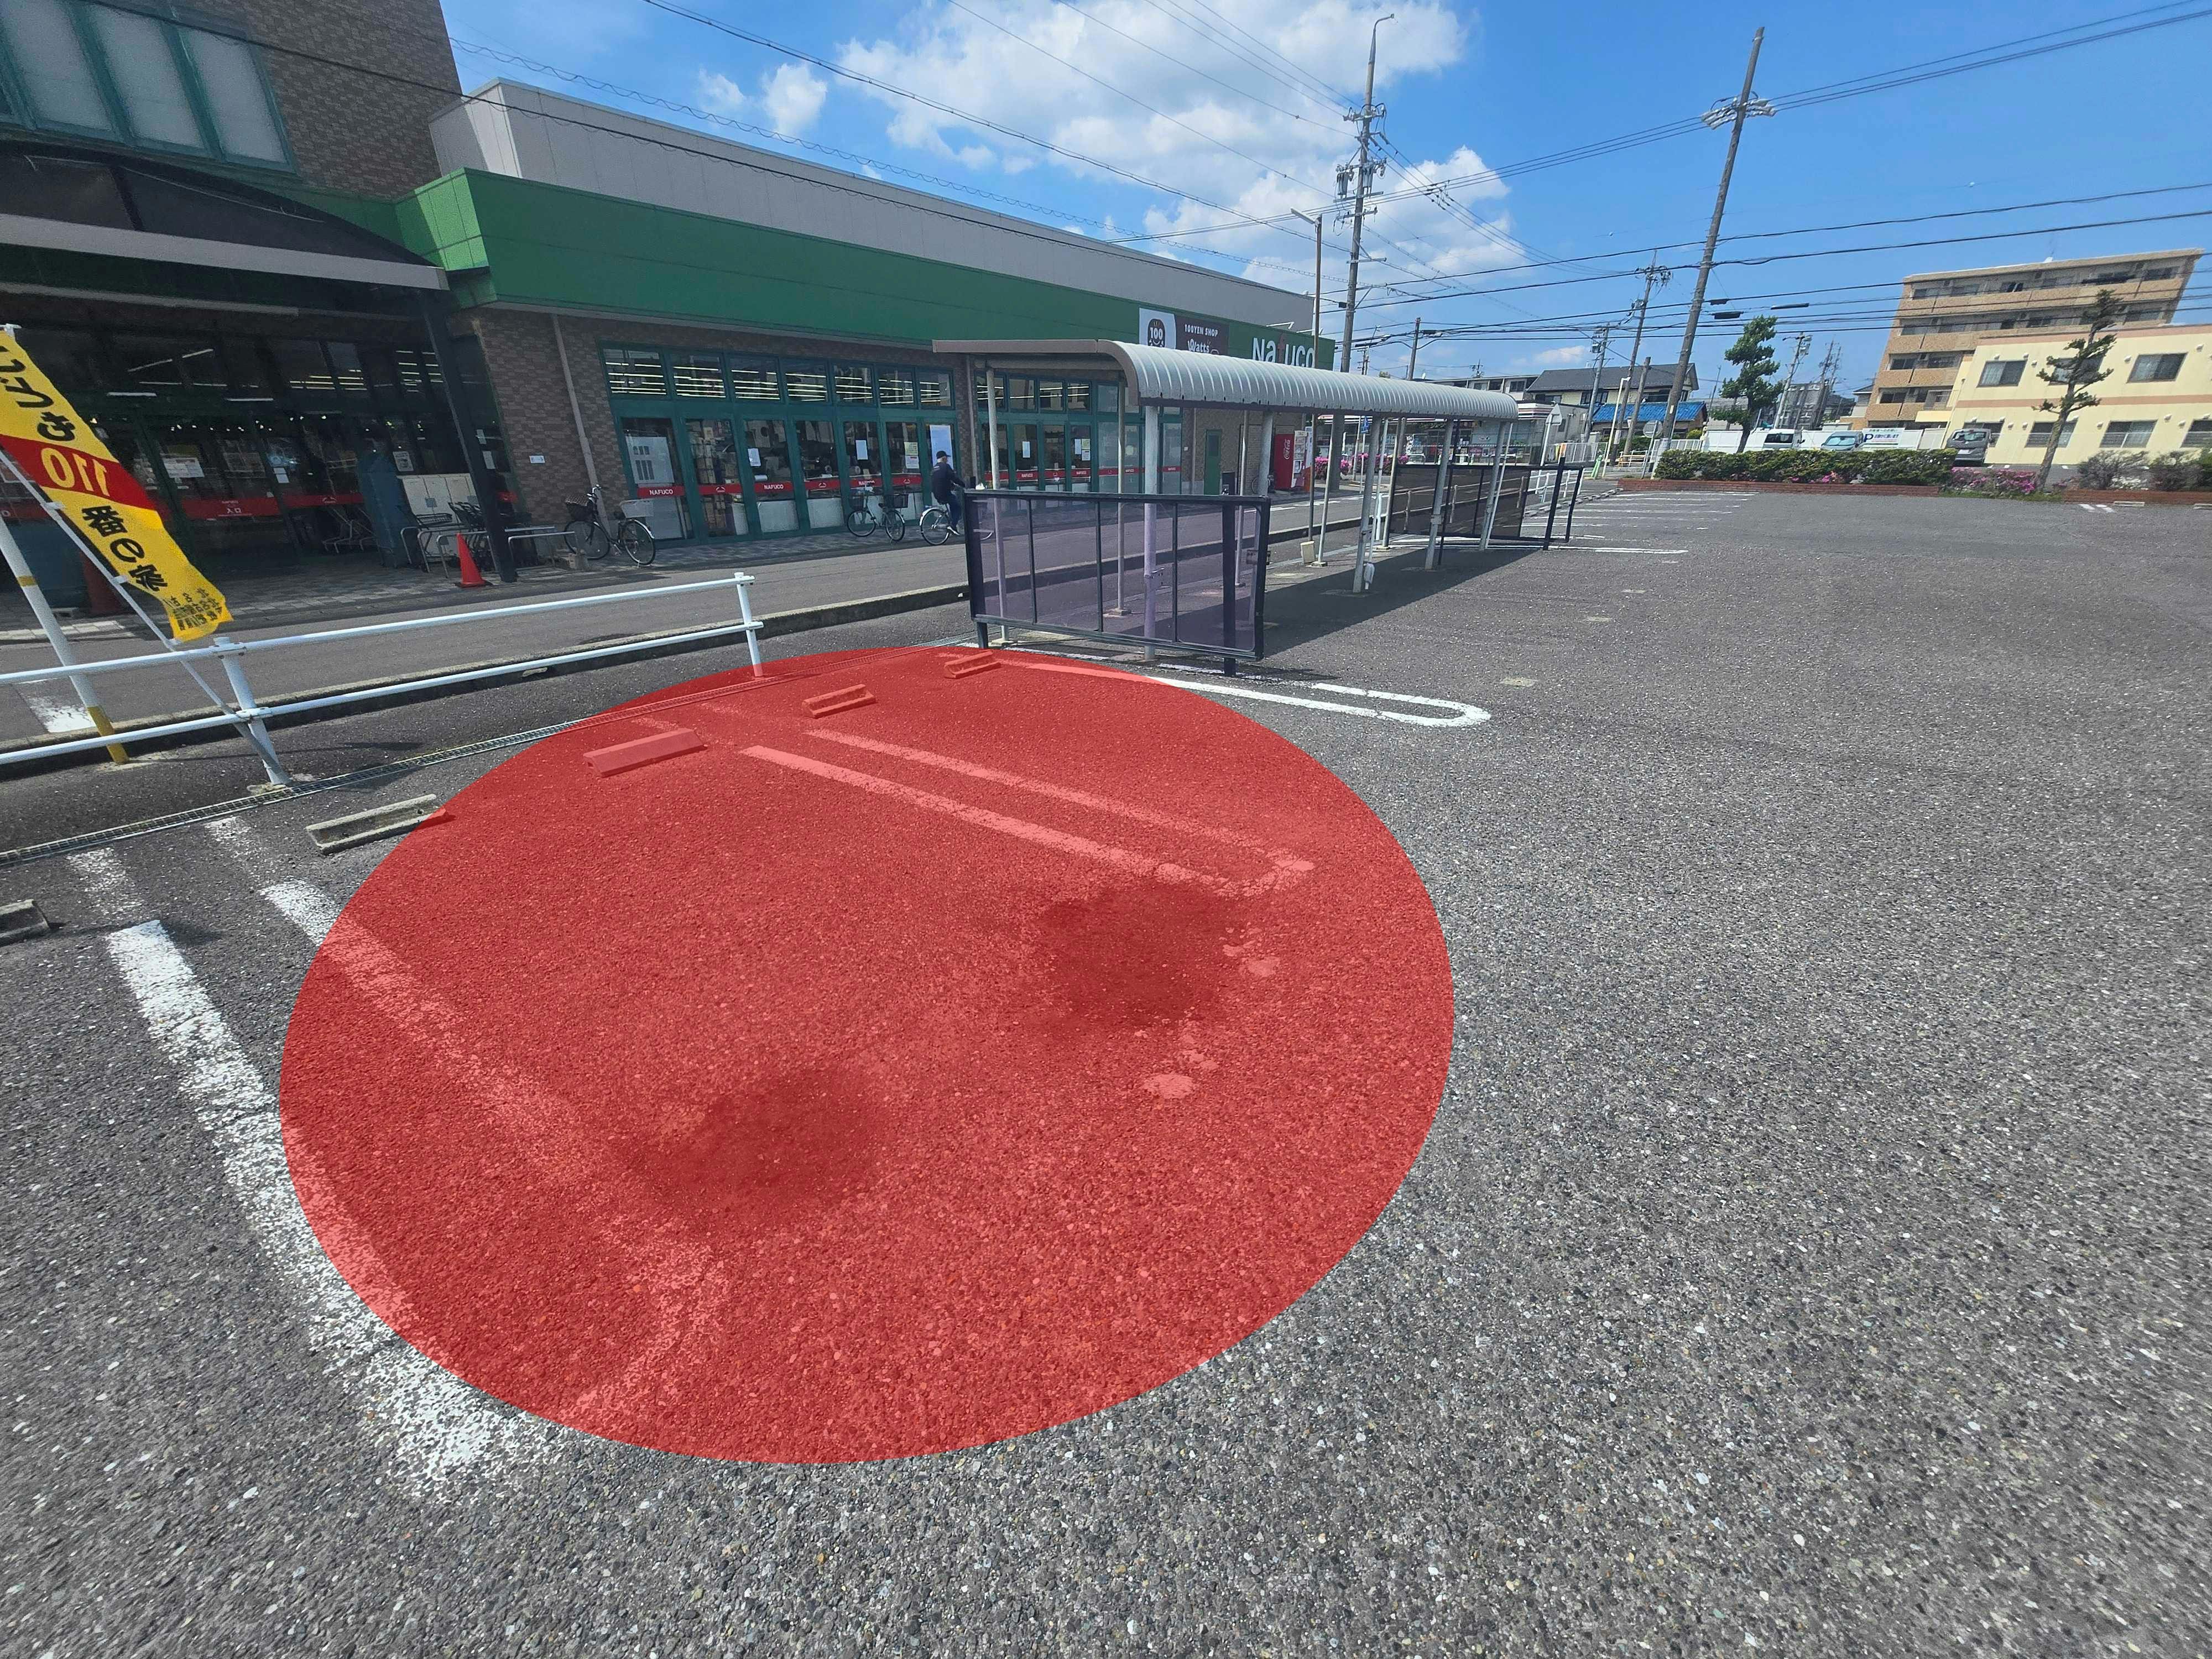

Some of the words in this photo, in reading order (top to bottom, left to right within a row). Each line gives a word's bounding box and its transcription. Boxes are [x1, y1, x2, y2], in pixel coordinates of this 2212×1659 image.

[1150, 327, 1164, 340] 100
[1185, 324, 1204, 335] 100YEN
[1205, 328, 1218, 337] SHOP
[1187, 338, 1209, 353] Watts
